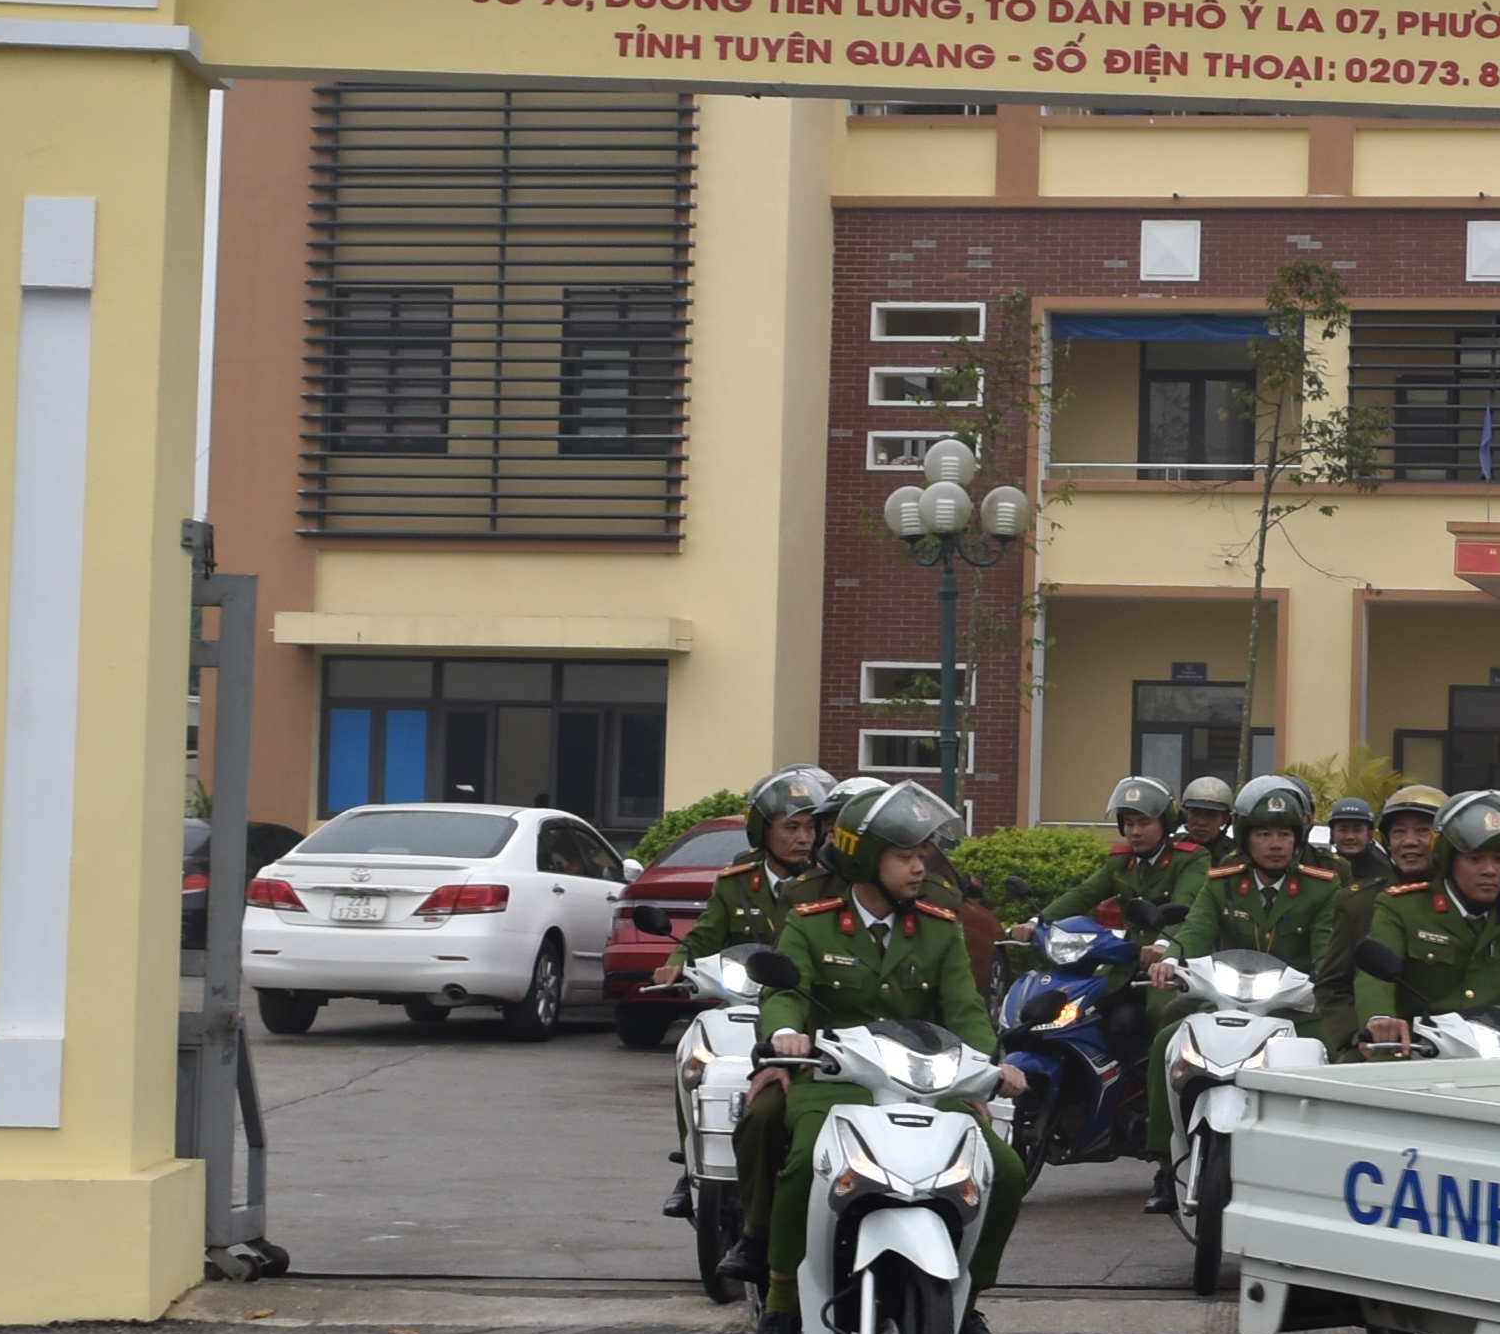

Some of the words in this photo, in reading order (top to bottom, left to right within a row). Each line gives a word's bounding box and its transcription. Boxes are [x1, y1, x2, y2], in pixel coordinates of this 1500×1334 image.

[1276, 5, 1325, 33] LA
[1335, 7, 1388, 38] 07,
[615, 24, 703, 60] TỈNH
[715, 30, 834, 64] TUYÊN
[846, 38, 996, 71] QUANG
[1008, 53, 1022, 62] -
[1033, 32, 1087, 74] SỐ
[1103, 41, 1189, 83] ĐIỆN
[1204, 51, 1337, 87] THOẠI:
[1344, 56, 1470, 88] 02073.
